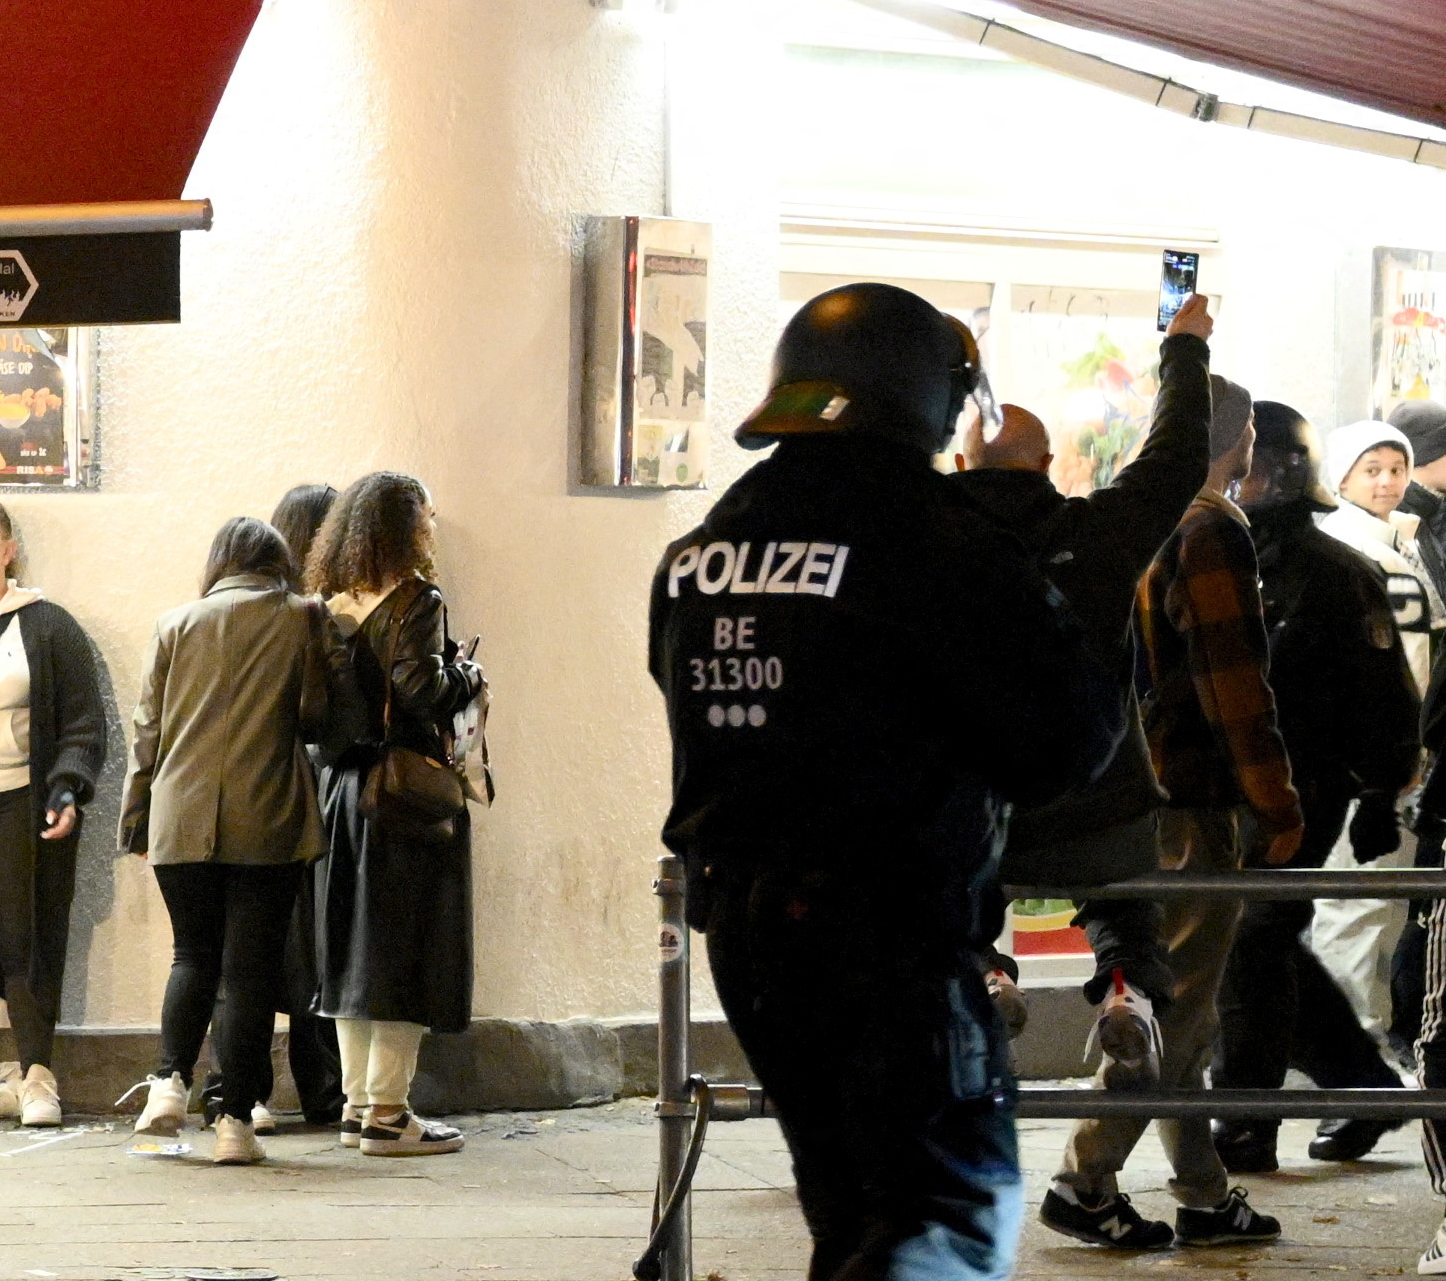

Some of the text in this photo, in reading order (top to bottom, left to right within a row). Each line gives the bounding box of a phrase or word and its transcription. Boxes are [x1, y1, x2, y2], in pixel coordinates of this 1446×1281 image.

[18, 361, 34, 375] DIP
[668, 541, 850, 598] POLIZEI
[714, 617, 757, 650] BE
[689, 656, 783, 691] 31300
